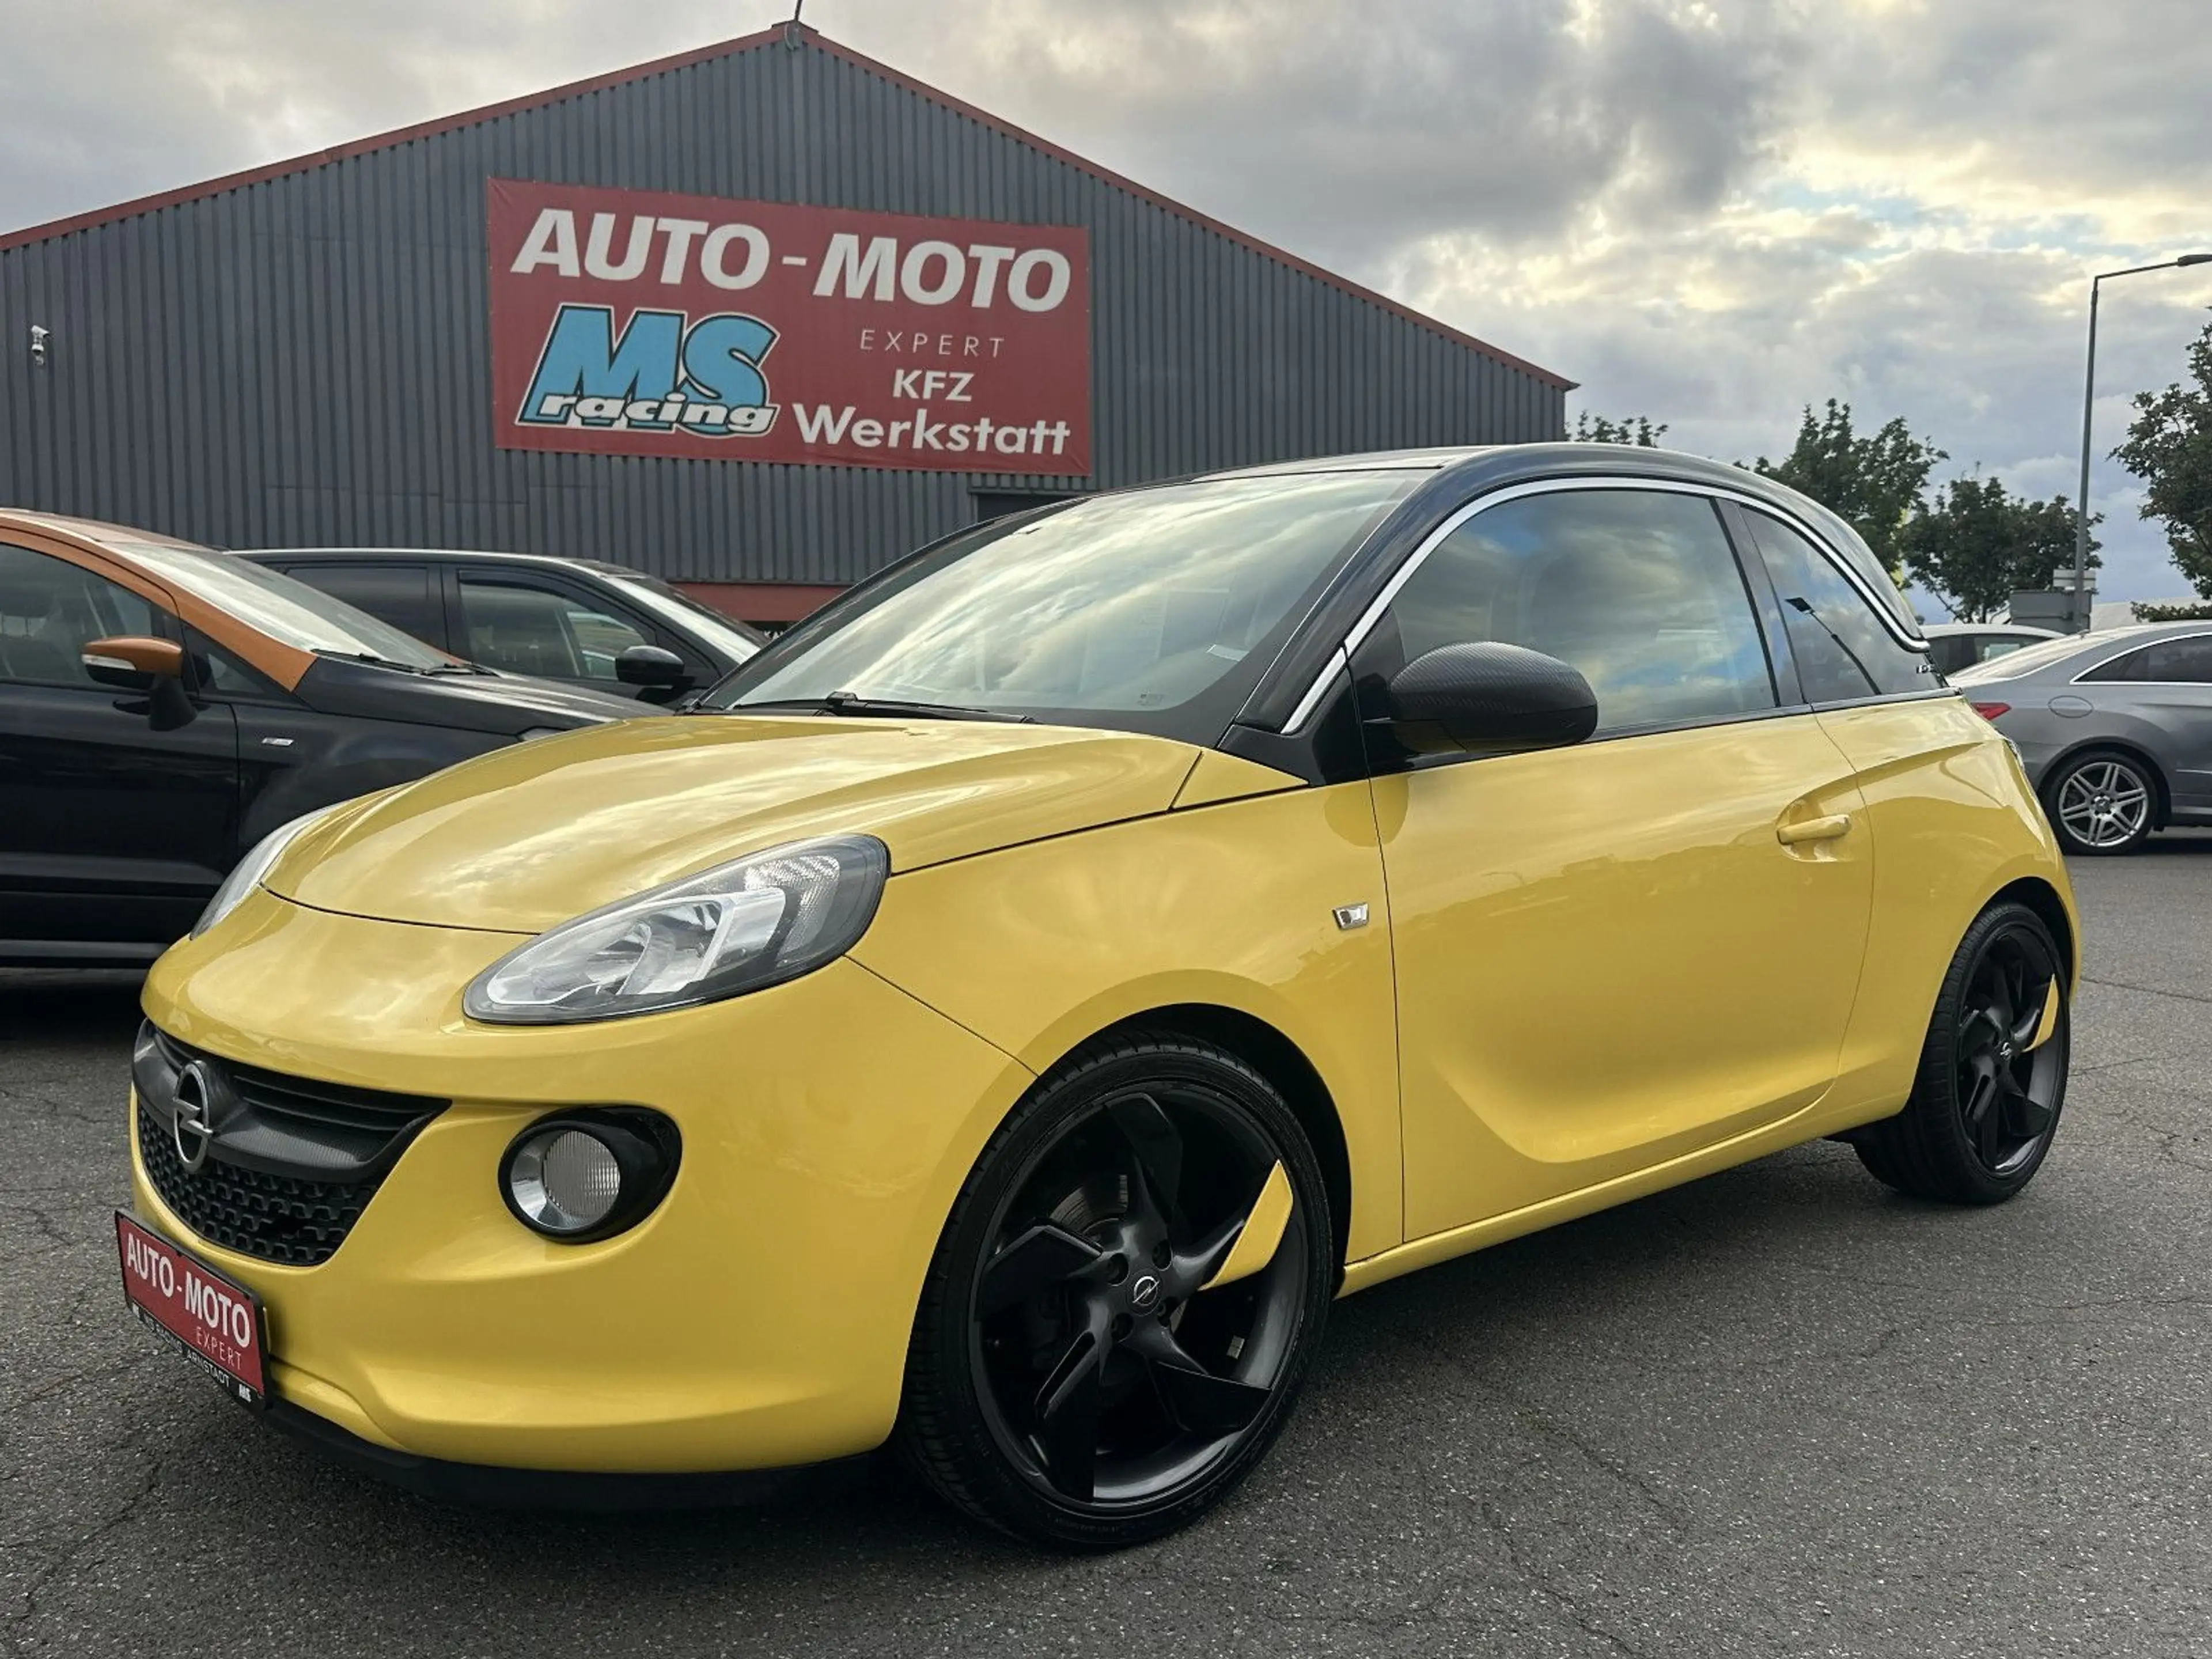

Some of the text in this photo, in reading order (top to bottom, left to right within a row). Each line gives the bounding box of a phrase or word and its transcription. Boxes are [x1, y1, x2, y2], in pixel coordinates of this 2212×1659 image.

[510, 209, 770, 290] AUTO
[813, 233, 1070, 312] MOTO
[861, 329, 1003, 357] EXPERT
[516, 303, 780, 438] MS
[893, 369, 974, 402] KFZ
[538, 392, 777, 433] racing
[793, 404, 1070, 454] Werkstatt
[127, 1233, 174, 1298] AUTO
[185, 1271, 251, 1349] MOTO
[196, 1325, 242, 1370] EXPERT
